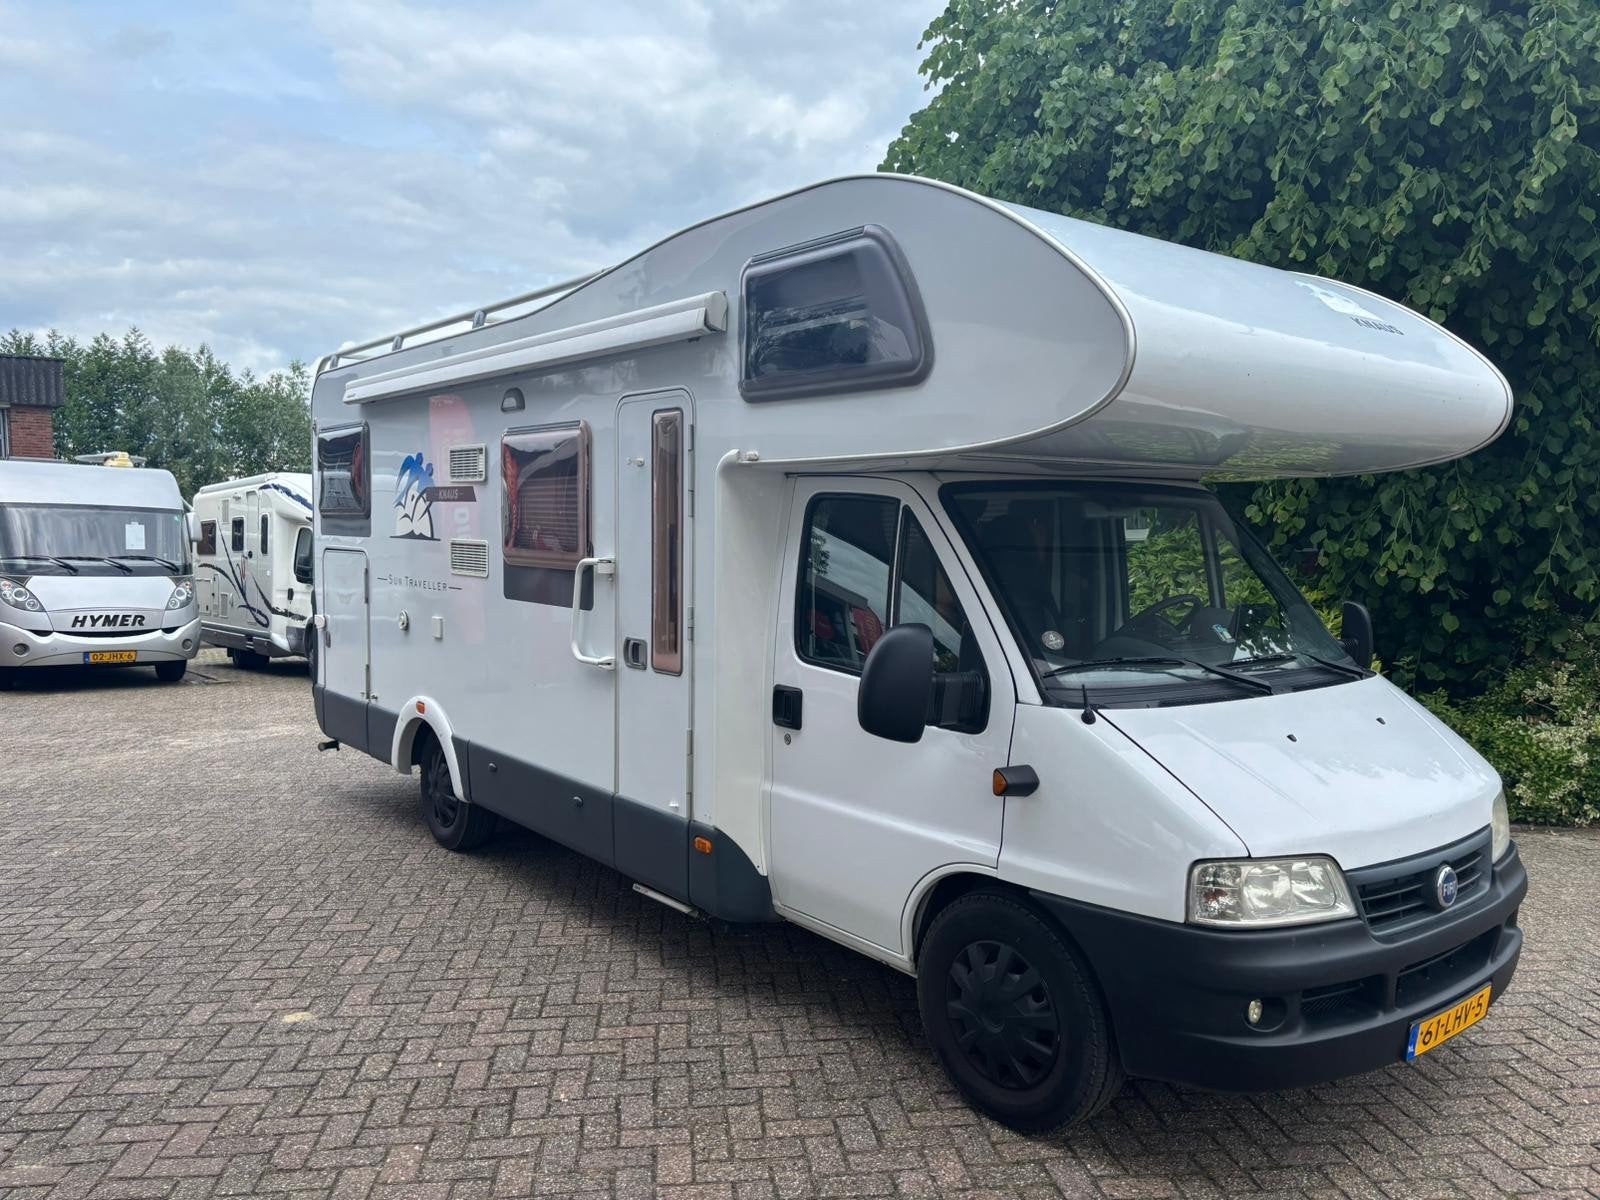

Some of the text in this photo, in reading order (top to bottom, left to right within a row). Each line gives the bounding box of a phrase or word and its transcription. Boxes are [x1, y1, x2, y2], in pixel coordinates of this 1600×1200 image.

[1350, 316, 1404, 336] KNAUS
[438, 488, 459, 499] KNAUS
[405, 576, 448, 591] TRAVELLER
[71, 614, 146, 628] HYMER
[92, 652, 134, 661] 02-JHX-6
[1422, 994, 1484, 1046] 61-LHV-5
